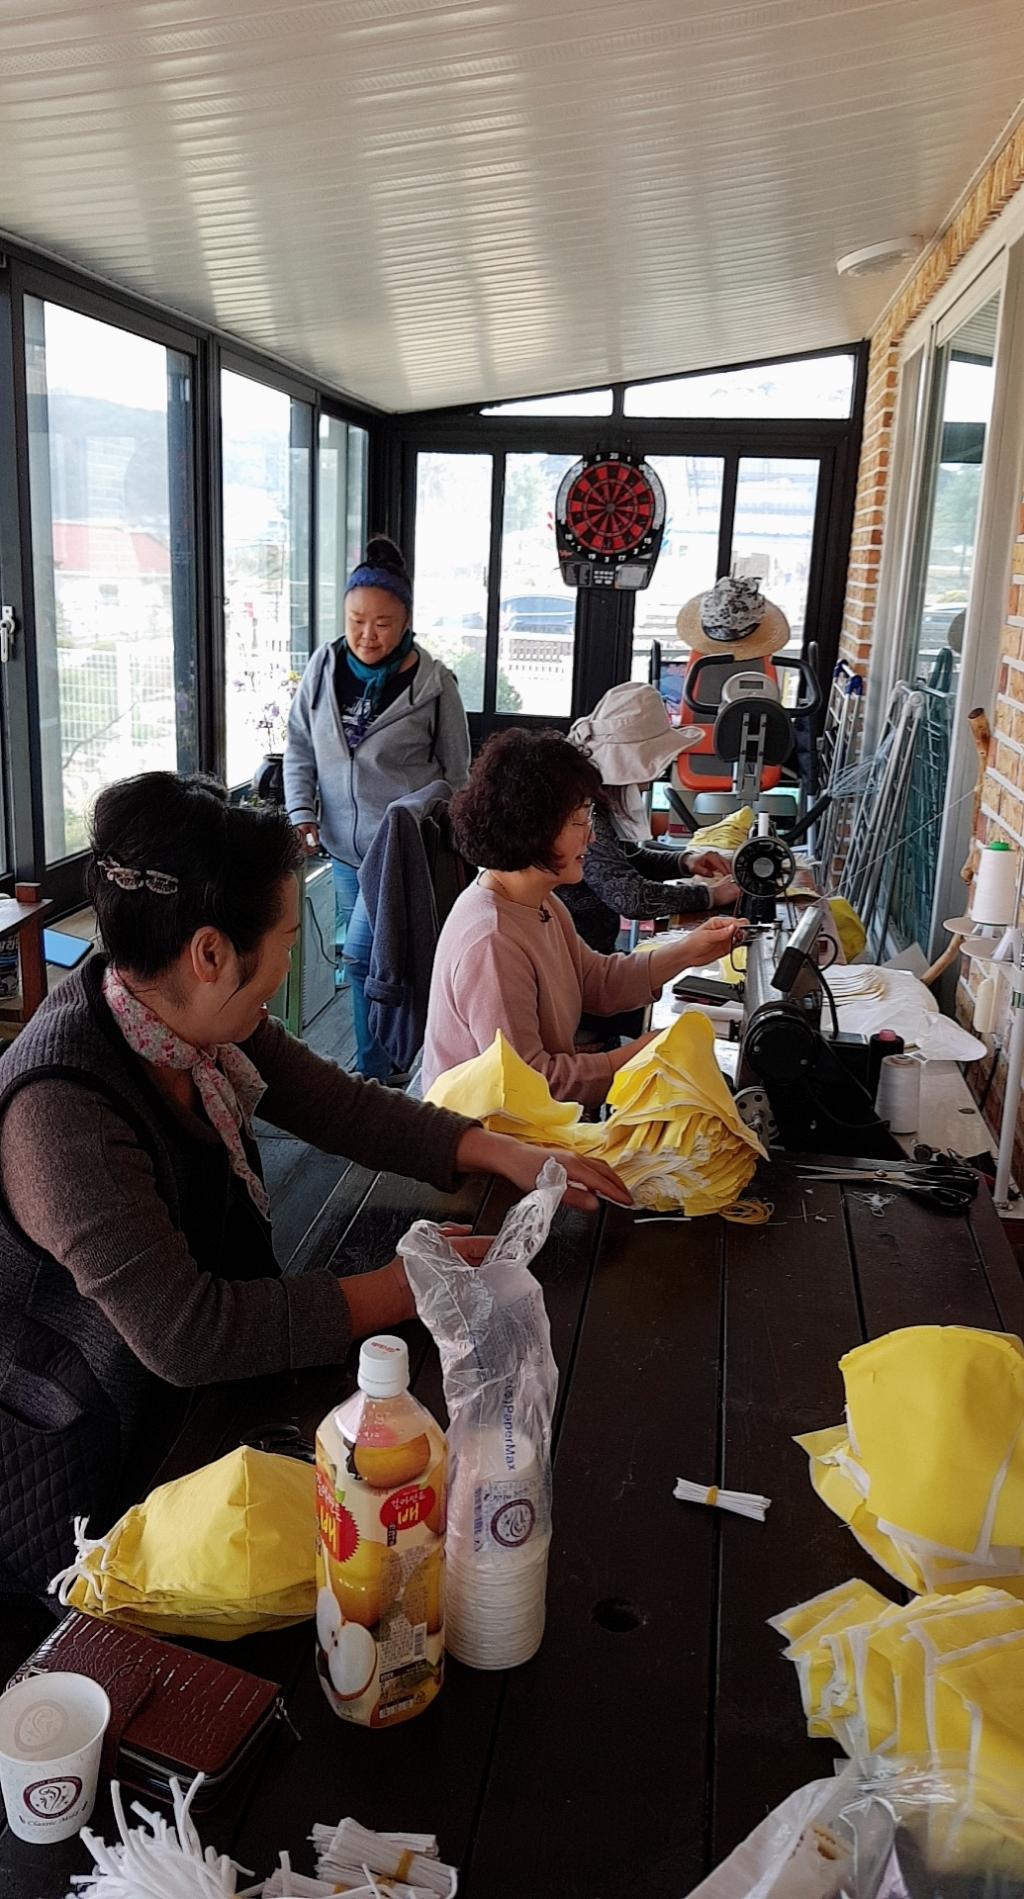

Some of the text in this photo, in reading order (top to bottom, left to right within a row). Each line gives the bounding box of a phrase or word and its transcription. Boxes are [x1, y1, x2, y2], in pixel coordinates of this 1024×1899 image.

[609, 452, 619, 460] 20
[396, 1502, 420, 1526] 배
[319, 1504, 337, 1554] 배
